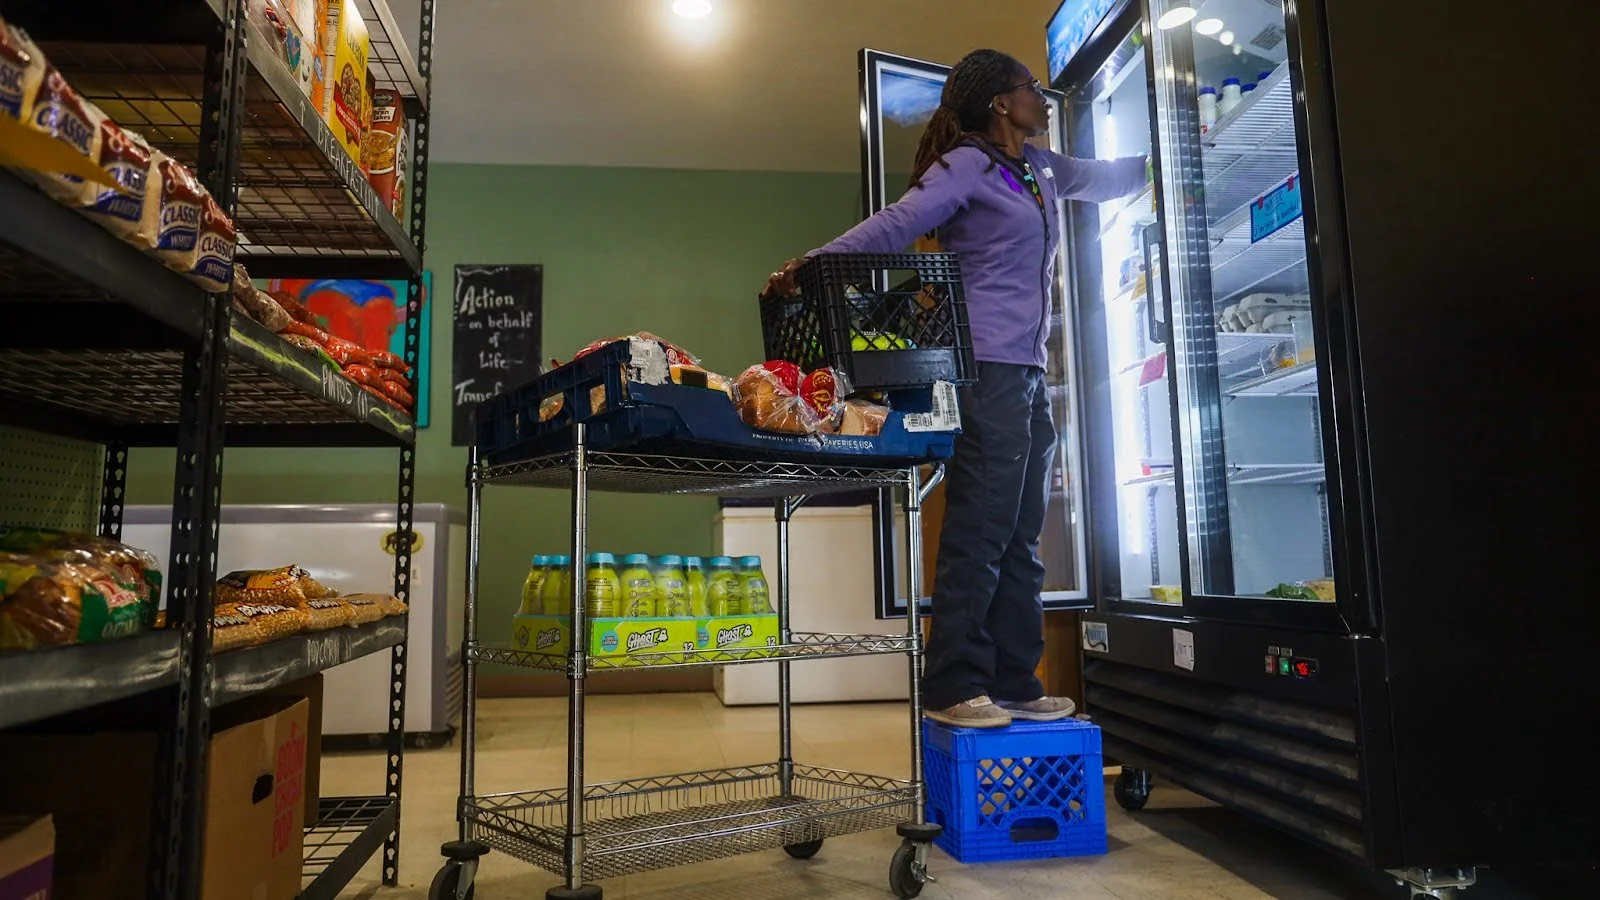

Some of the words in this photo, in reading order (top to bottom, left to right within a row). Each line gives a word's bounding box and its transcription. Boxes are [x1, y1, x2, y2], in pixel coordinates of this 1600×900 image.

[201, 236, 235, 260] CLASSIC
[206, 262, 229, 281] WHITE
[459, 285, 515, 316] Action
[469, 319, 483, 329] on
[488, 310, 534, 329] behalf
[488, 331, 500, 348] of
[479, 350, 509, 370] Life
[322, 364, 353, 405] PINTOS
[859, 441, 874, 450] USA
[626, 627, 662, 653] GHOST
[716, 624, 748, 648] GHOST
[766, 636, 777, 647] 12
[683, 641, 695, 652] 12
